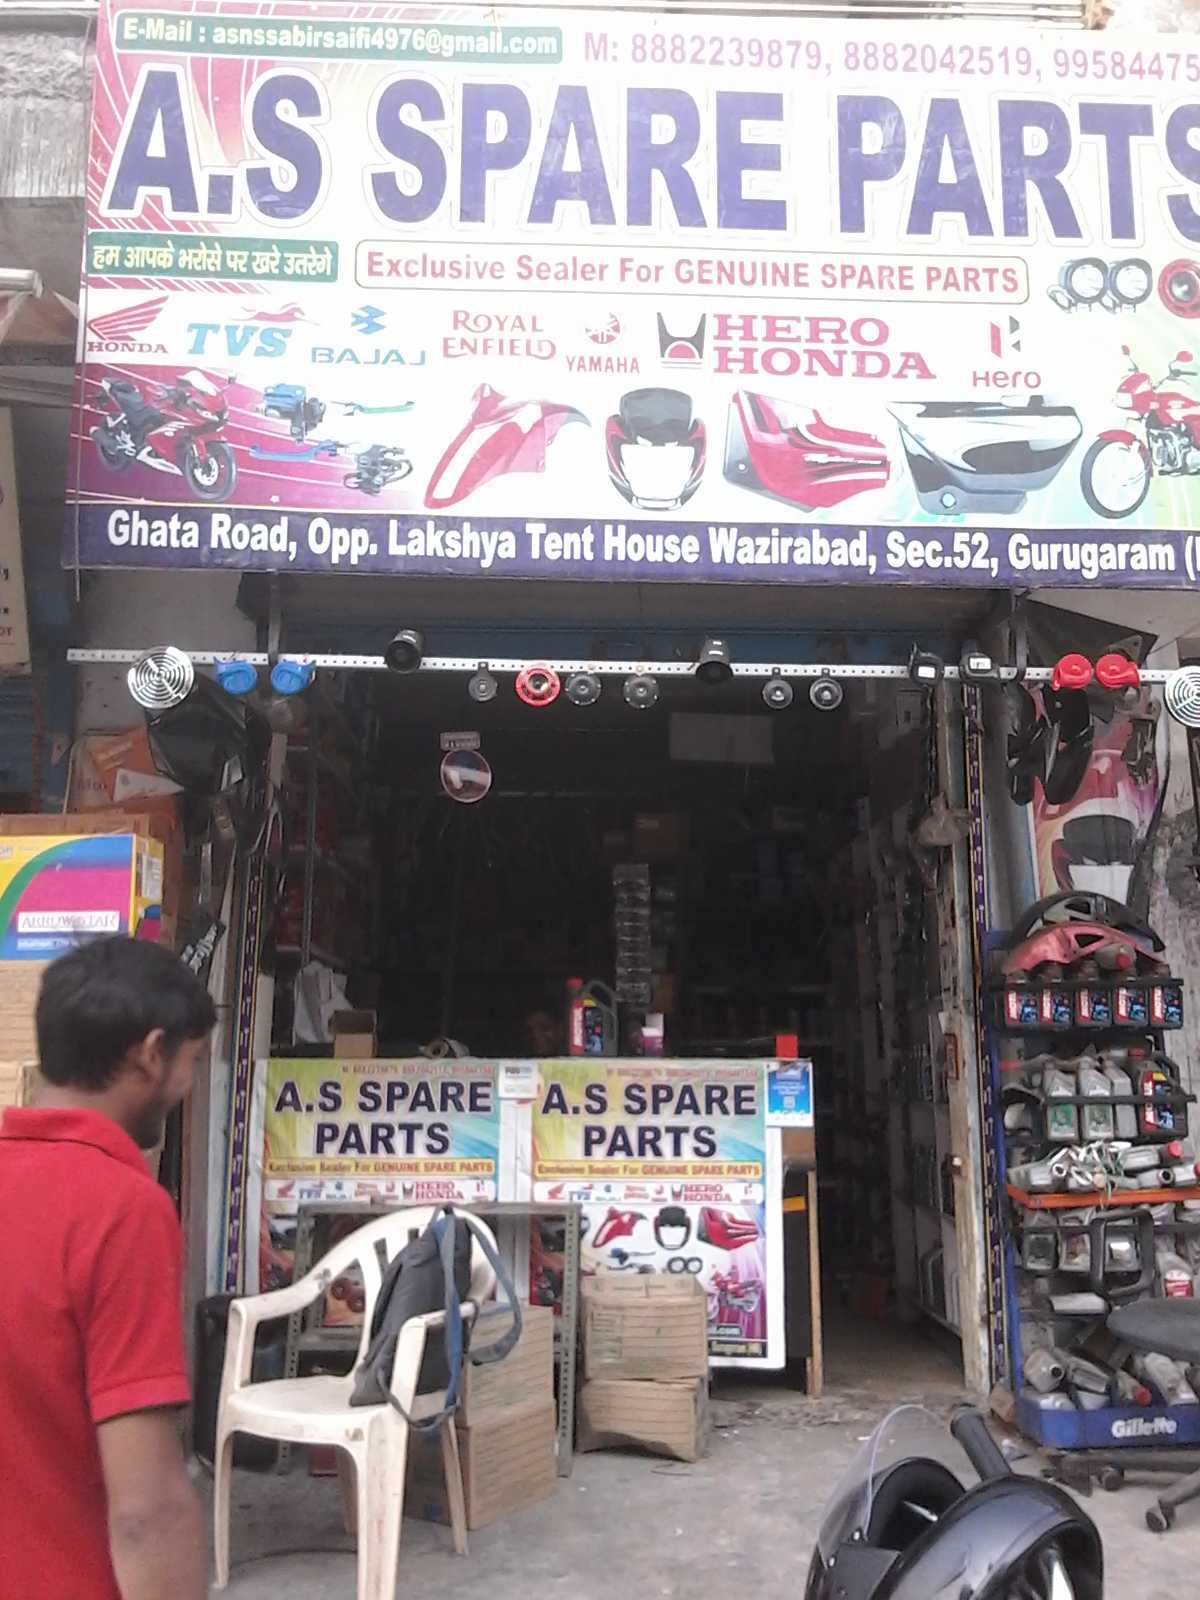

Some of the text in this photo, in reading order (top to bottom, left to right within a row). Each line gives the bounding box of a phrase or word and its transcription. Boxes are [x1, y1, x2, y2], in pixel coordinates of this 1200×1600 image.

[124, 17, 192, 42] E-Mail
[585, 32, 1200, 83] M: 8882239879, 8882042519, 99584475
[108, 69, 323, 220] A.S
[371, 78, 788, 231] SPARE
[92, 244, 121, 269] हम
[124, 240, 174, 269] आपके
[178, 241, 221, 271] भरोसे
[226, 250, 248, 273] पर
[251, 244, 280, 274] खरे
[367, 251, 1019, 293] Exclusive Sealer For GENUINE SPARE PARTS
[452, 309, 543, 333] ROYAL
[713, 313, 889, 346] HERO
[87, 341, 168, 354] HONDA
[186, 323, 293, 357] TVS
[443, 337, 556, 360] ENFIELD
[311, 347, 426, 366] BAJAJ
[566, 355, 640, 374] YAMAHA
[713, 347, 937, 379] HONDA
[107, 509, 199, 548] Ghata
[211, 513, 297, 561] Road,
[308, 518, 377, 564] Opp.
[388, 519, 516, 568] Lakshya
[526, 523, 594, 560] Tent
[604, 525, 700, 563] House
[709, 527, 877, 575] Wazirabad,
[886, 530, 999, 576] Sec.52,
[1008, 533, 1176, 580] Gurugaram
[275, 1081, 492, 1113] A.S SPARE
[542, 1084, 607, 1115] A.S
[624, 1084, 756, 1115] SPARE
[316, 1122, 450, 1155] PARTS
[583, 1125, 717, 1158] PARTS
[423, 1162, 456, 1173] SPARE
[460, 1162, 493, 1173] PARTS
